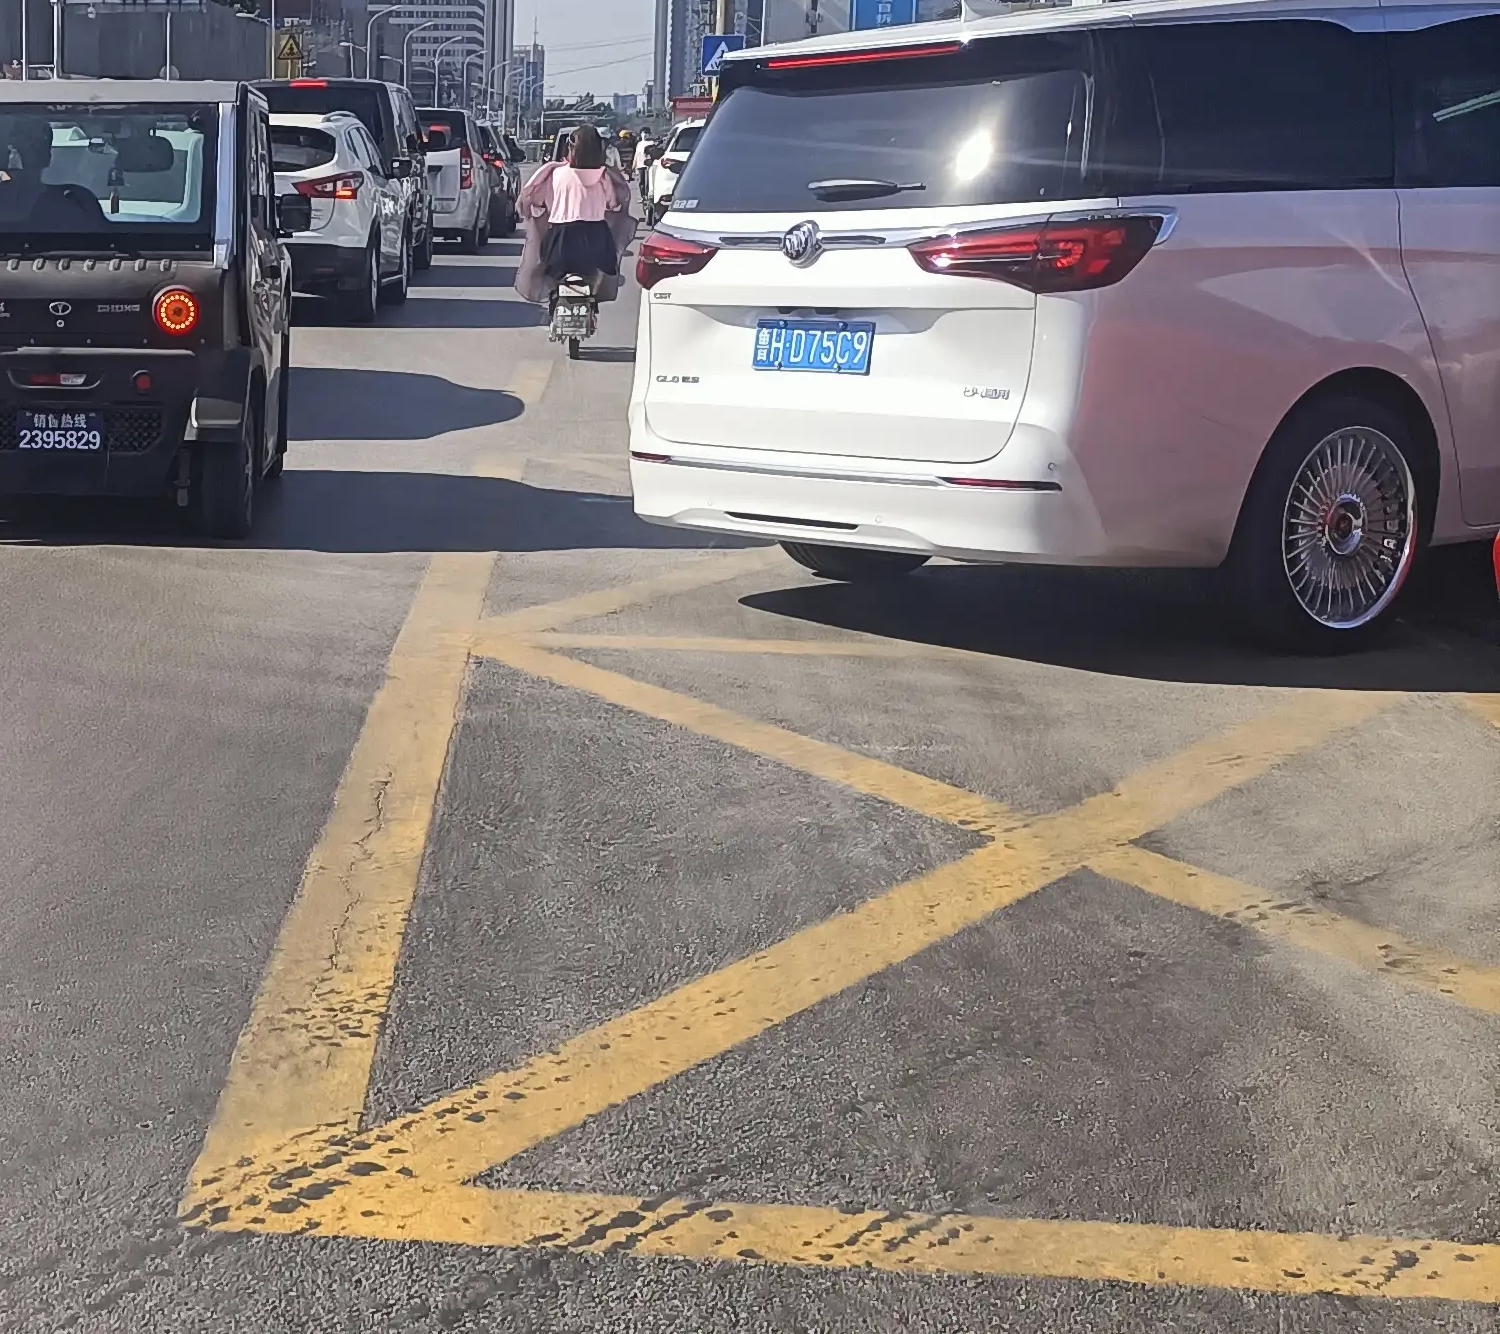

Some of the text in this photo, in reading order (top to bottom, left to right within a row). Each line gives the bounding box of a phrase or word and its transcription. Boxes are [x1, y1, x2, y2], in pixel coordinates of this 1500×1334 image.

[34, 413, 87, 428] 销售热线
[19, 429, 101, 449] 2395829
